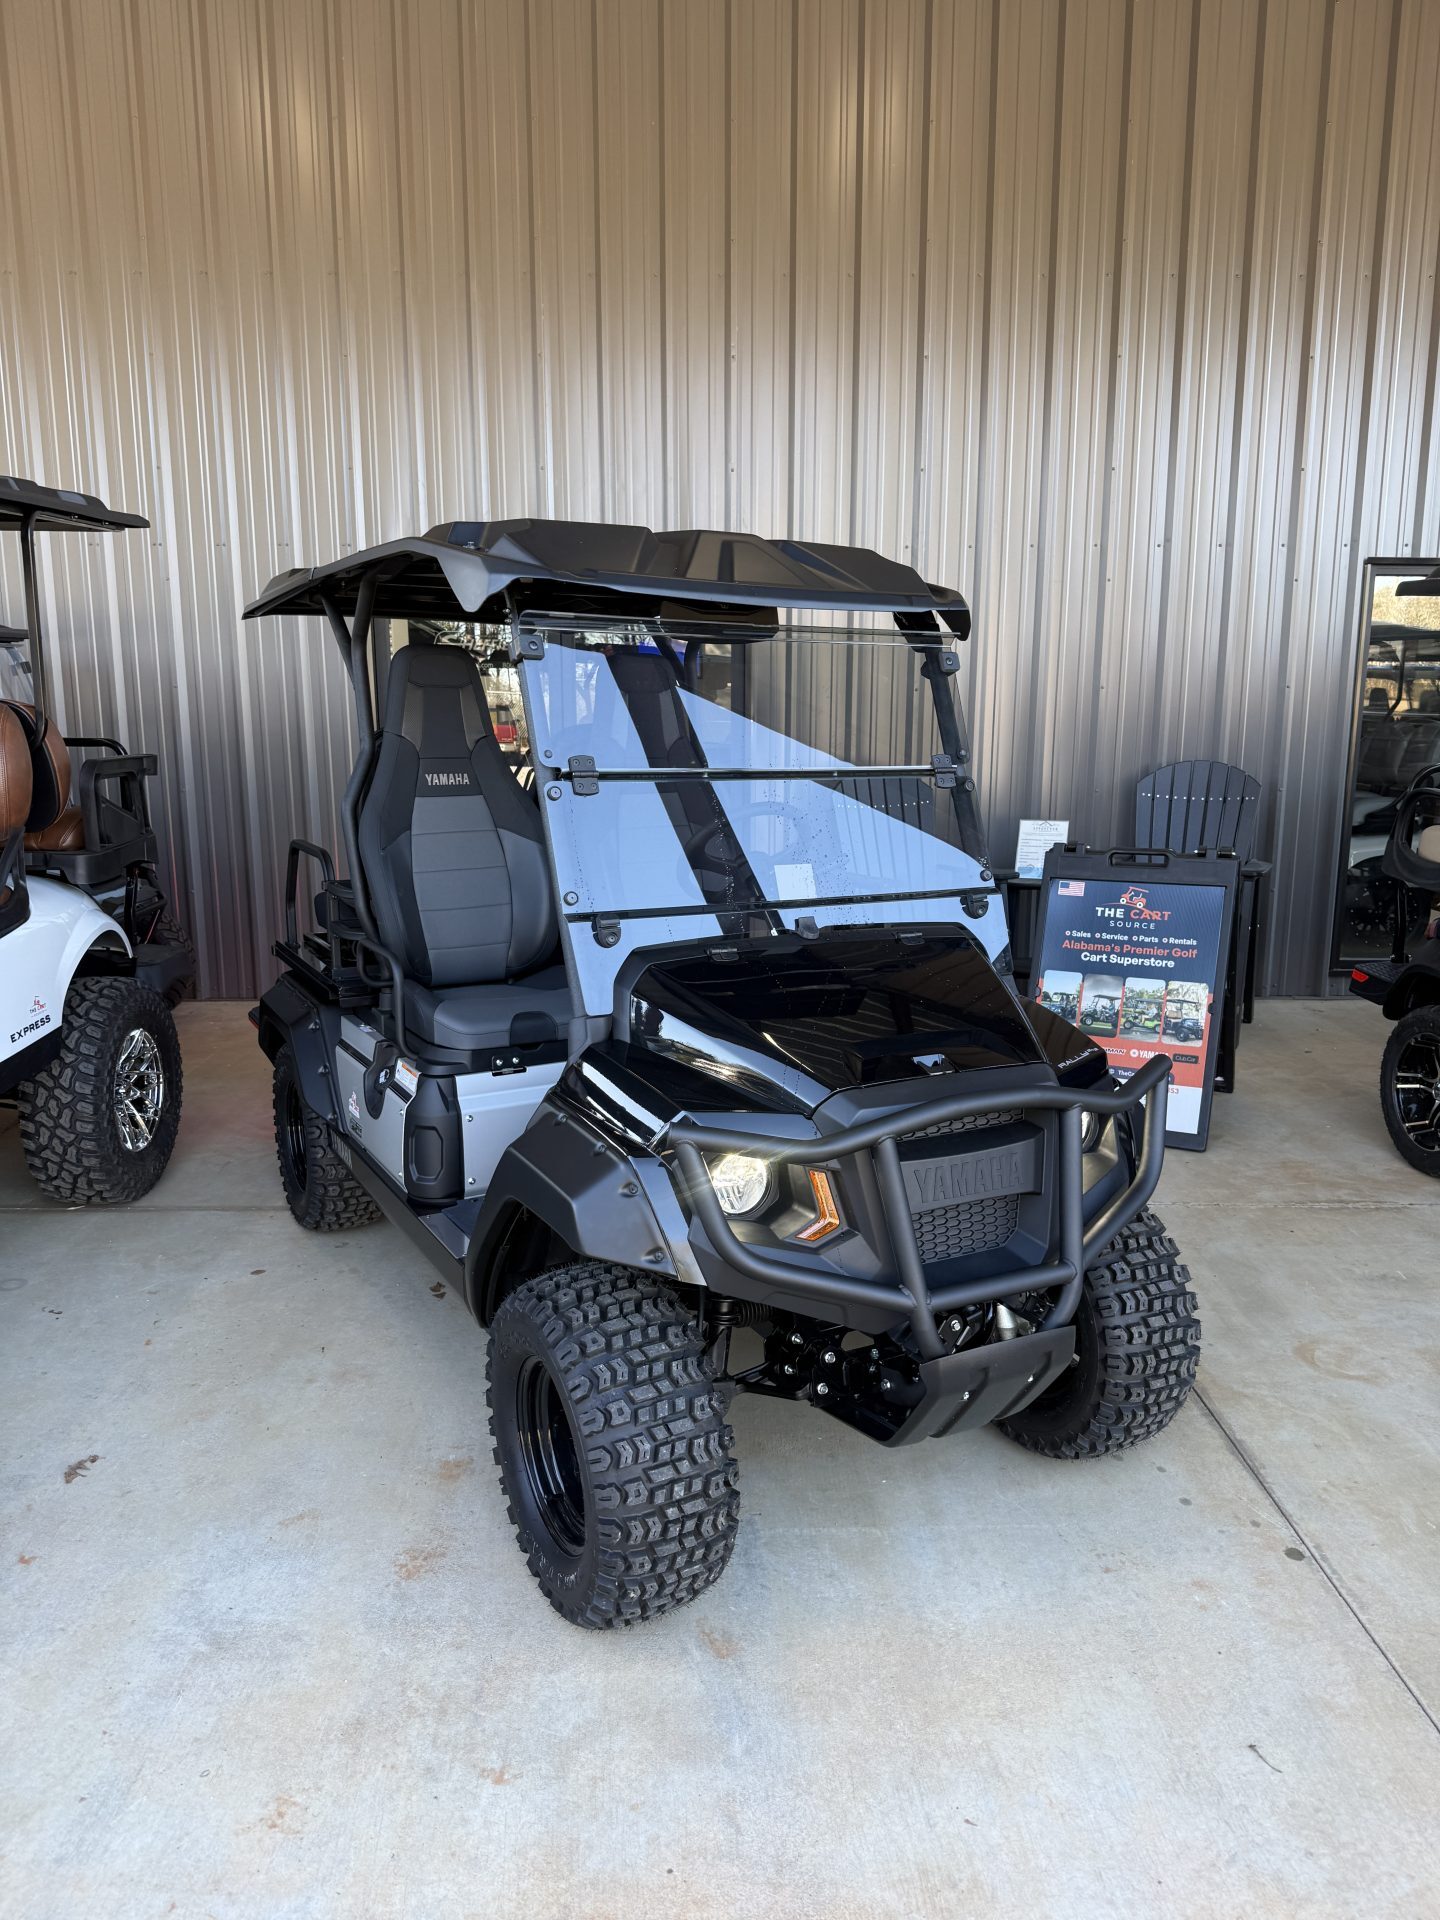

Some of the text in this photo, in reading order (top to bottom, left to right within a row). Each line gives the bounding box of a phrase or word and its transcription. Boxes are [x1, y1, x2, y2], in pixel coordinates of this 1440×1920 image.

[425, 773, 470, 786] YAMAHA
[1095, 906, 1171, 920] THE CART
[1109, 920, 1156, 930] SOURCE
[1071, 930, 1197, 946] Sales Service Parts Rentals
[1062, 939, 1198, 958] Alabama's Premier Golf
[1080, 951, 1175, 968] Cart Superstore
[10, 1014, 51, 1043] EXPRESS
[913, 1152, 1024, 1204] YAMAHA
